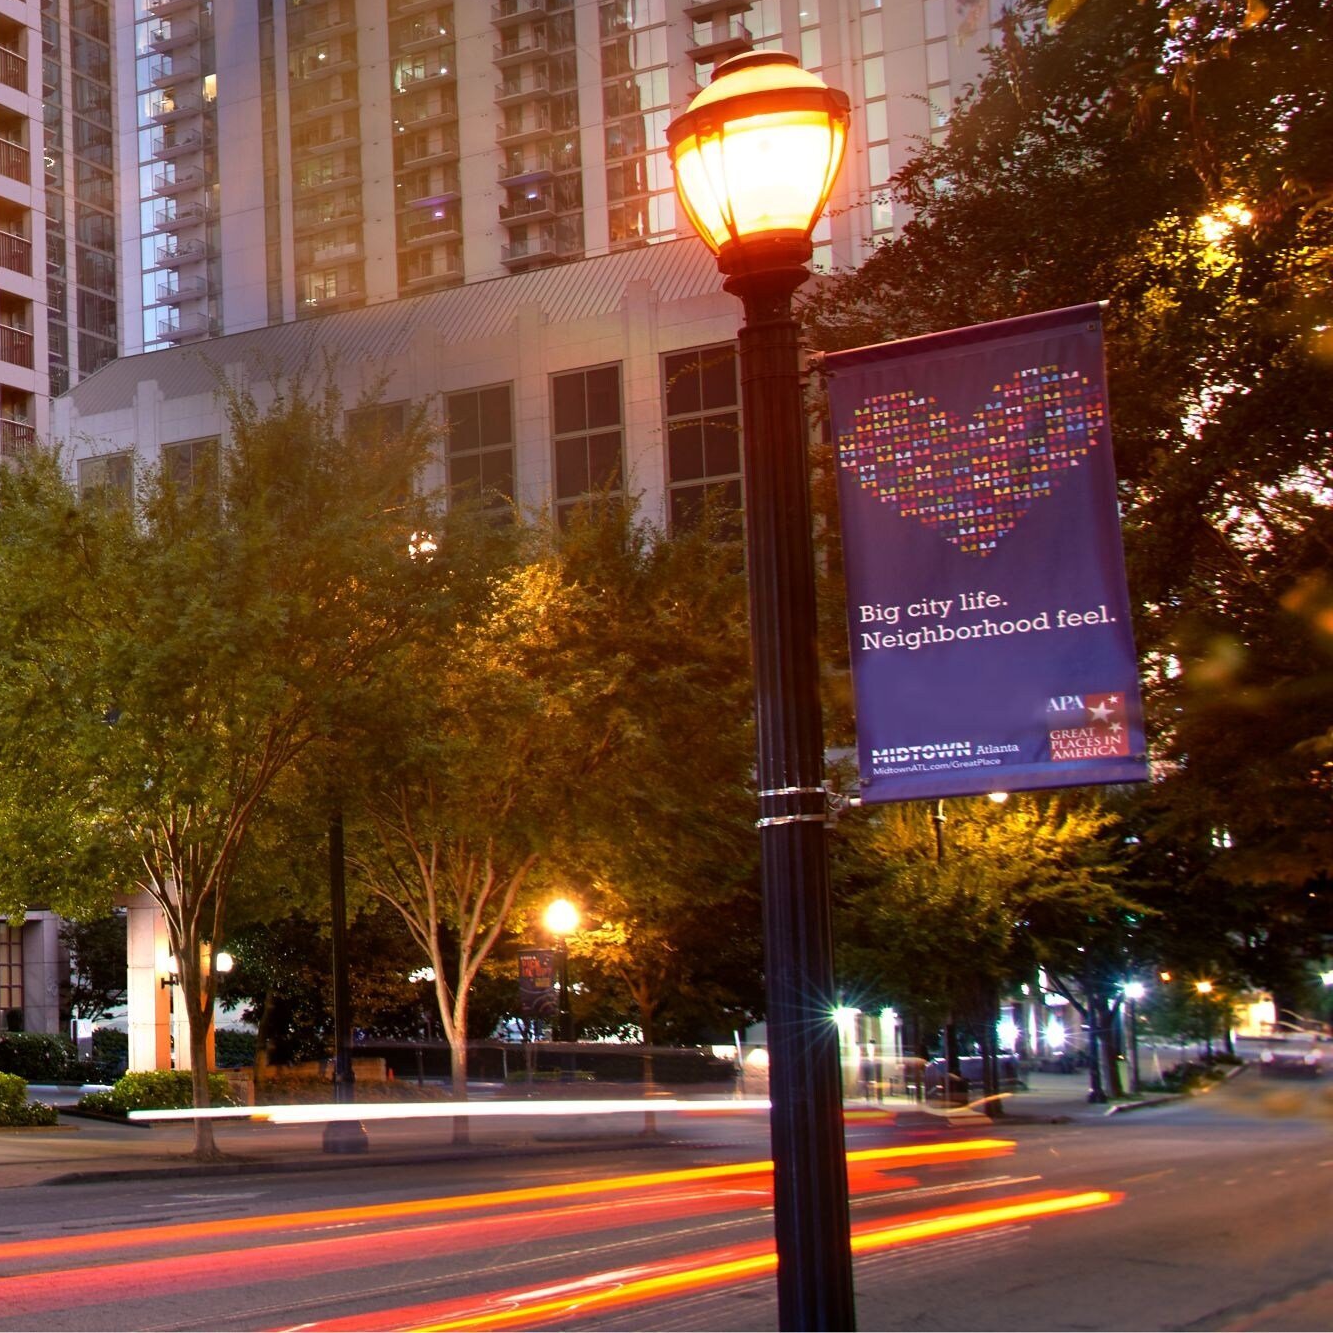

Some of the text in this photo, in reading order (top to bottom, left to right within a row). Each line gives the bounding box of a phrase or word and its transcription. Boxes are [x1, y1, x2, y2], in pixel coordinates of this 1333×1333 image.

[859, 591, 1008, 624] Big city life.
[861, 605, 1116, 650] Neighborhood feel.
[1046, 695, 1085, 712] APA
[1049, 727, 1095, 740] GREAT
[1051, 735, 1121, 750] PLACES IN
[872, 741, 1020, 764] MIDTOWN Atlanta
[1053, 745, 1118, 760] AMERICA
[873, 758, 1002, 775] MidtownATL.com/GreatPlace
